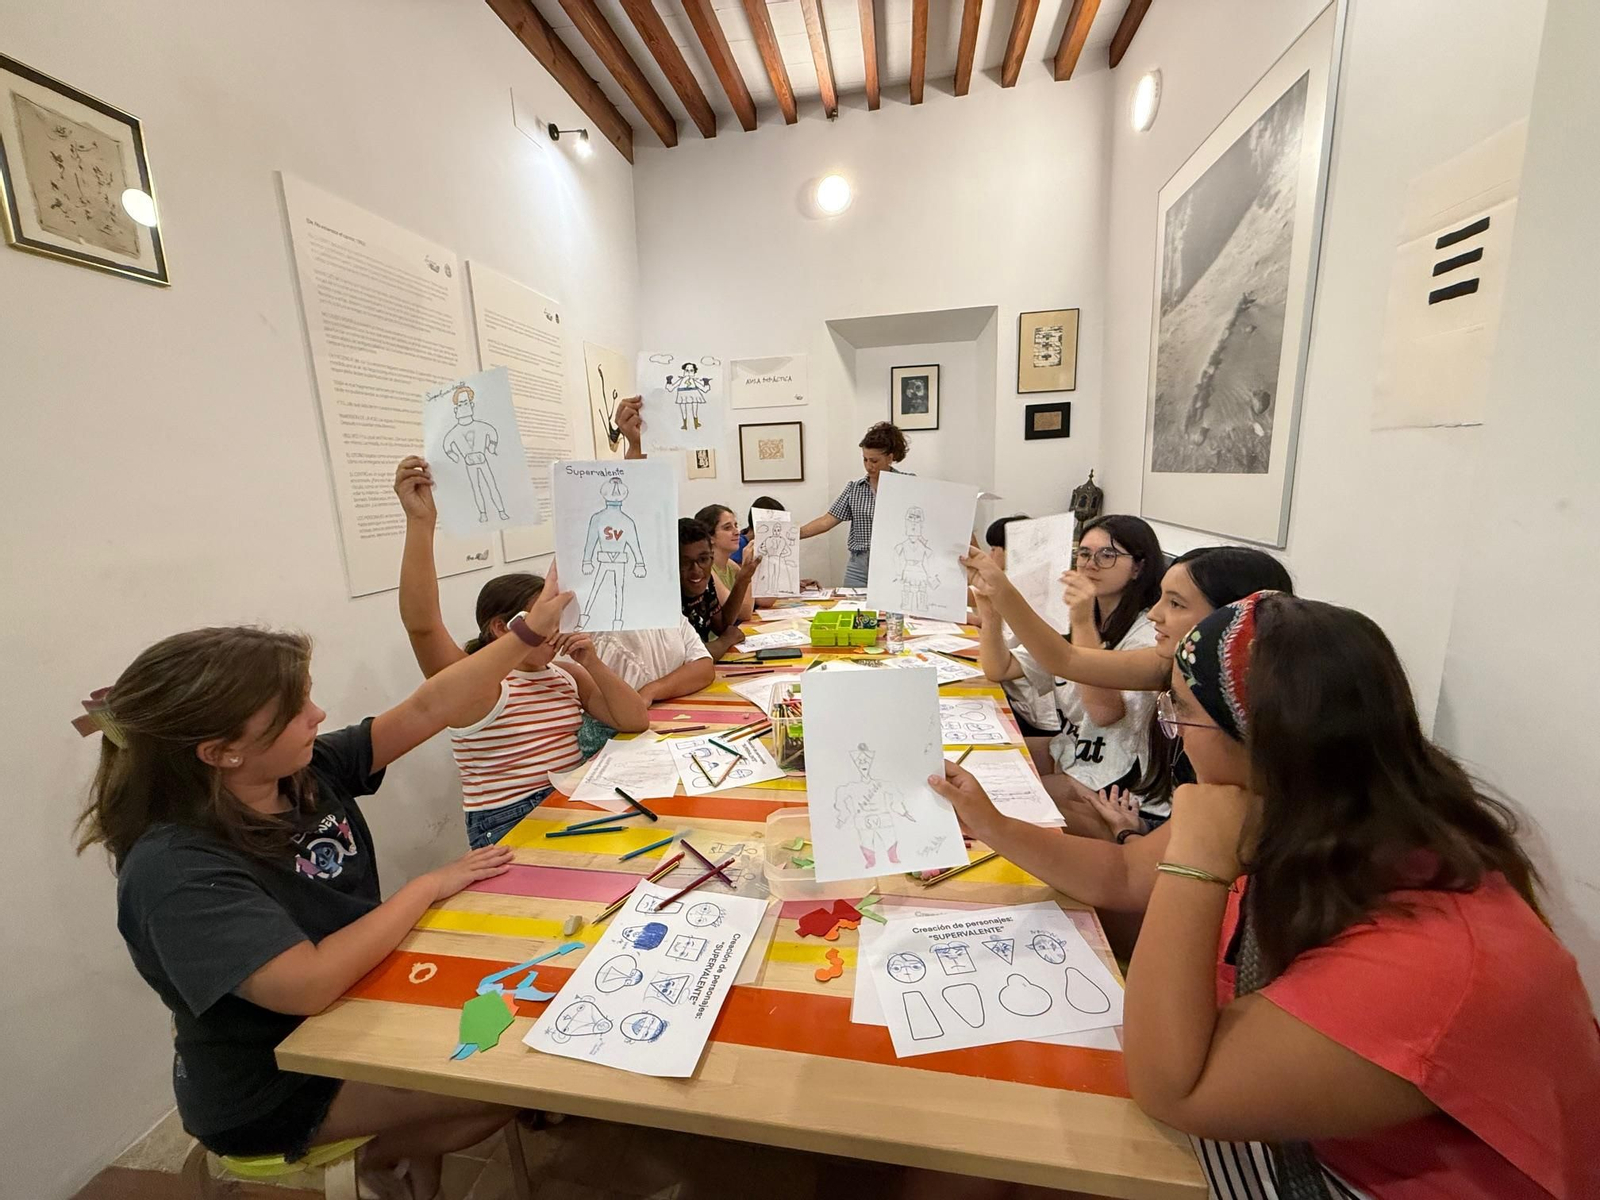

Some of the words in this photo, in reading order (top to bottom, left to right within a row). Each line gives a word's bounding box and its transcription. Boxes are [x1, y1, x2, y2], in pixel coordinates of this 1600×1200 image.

[565, 465, 625, 478] Supervalente
[912, 923, 951, 934] Creación
[965, 916, 1014, 928] personajes:
[723, 933, 741, 963] Creación
[716, 962, 727, 973] de
[695, 974, 720, 1019] personajes:
